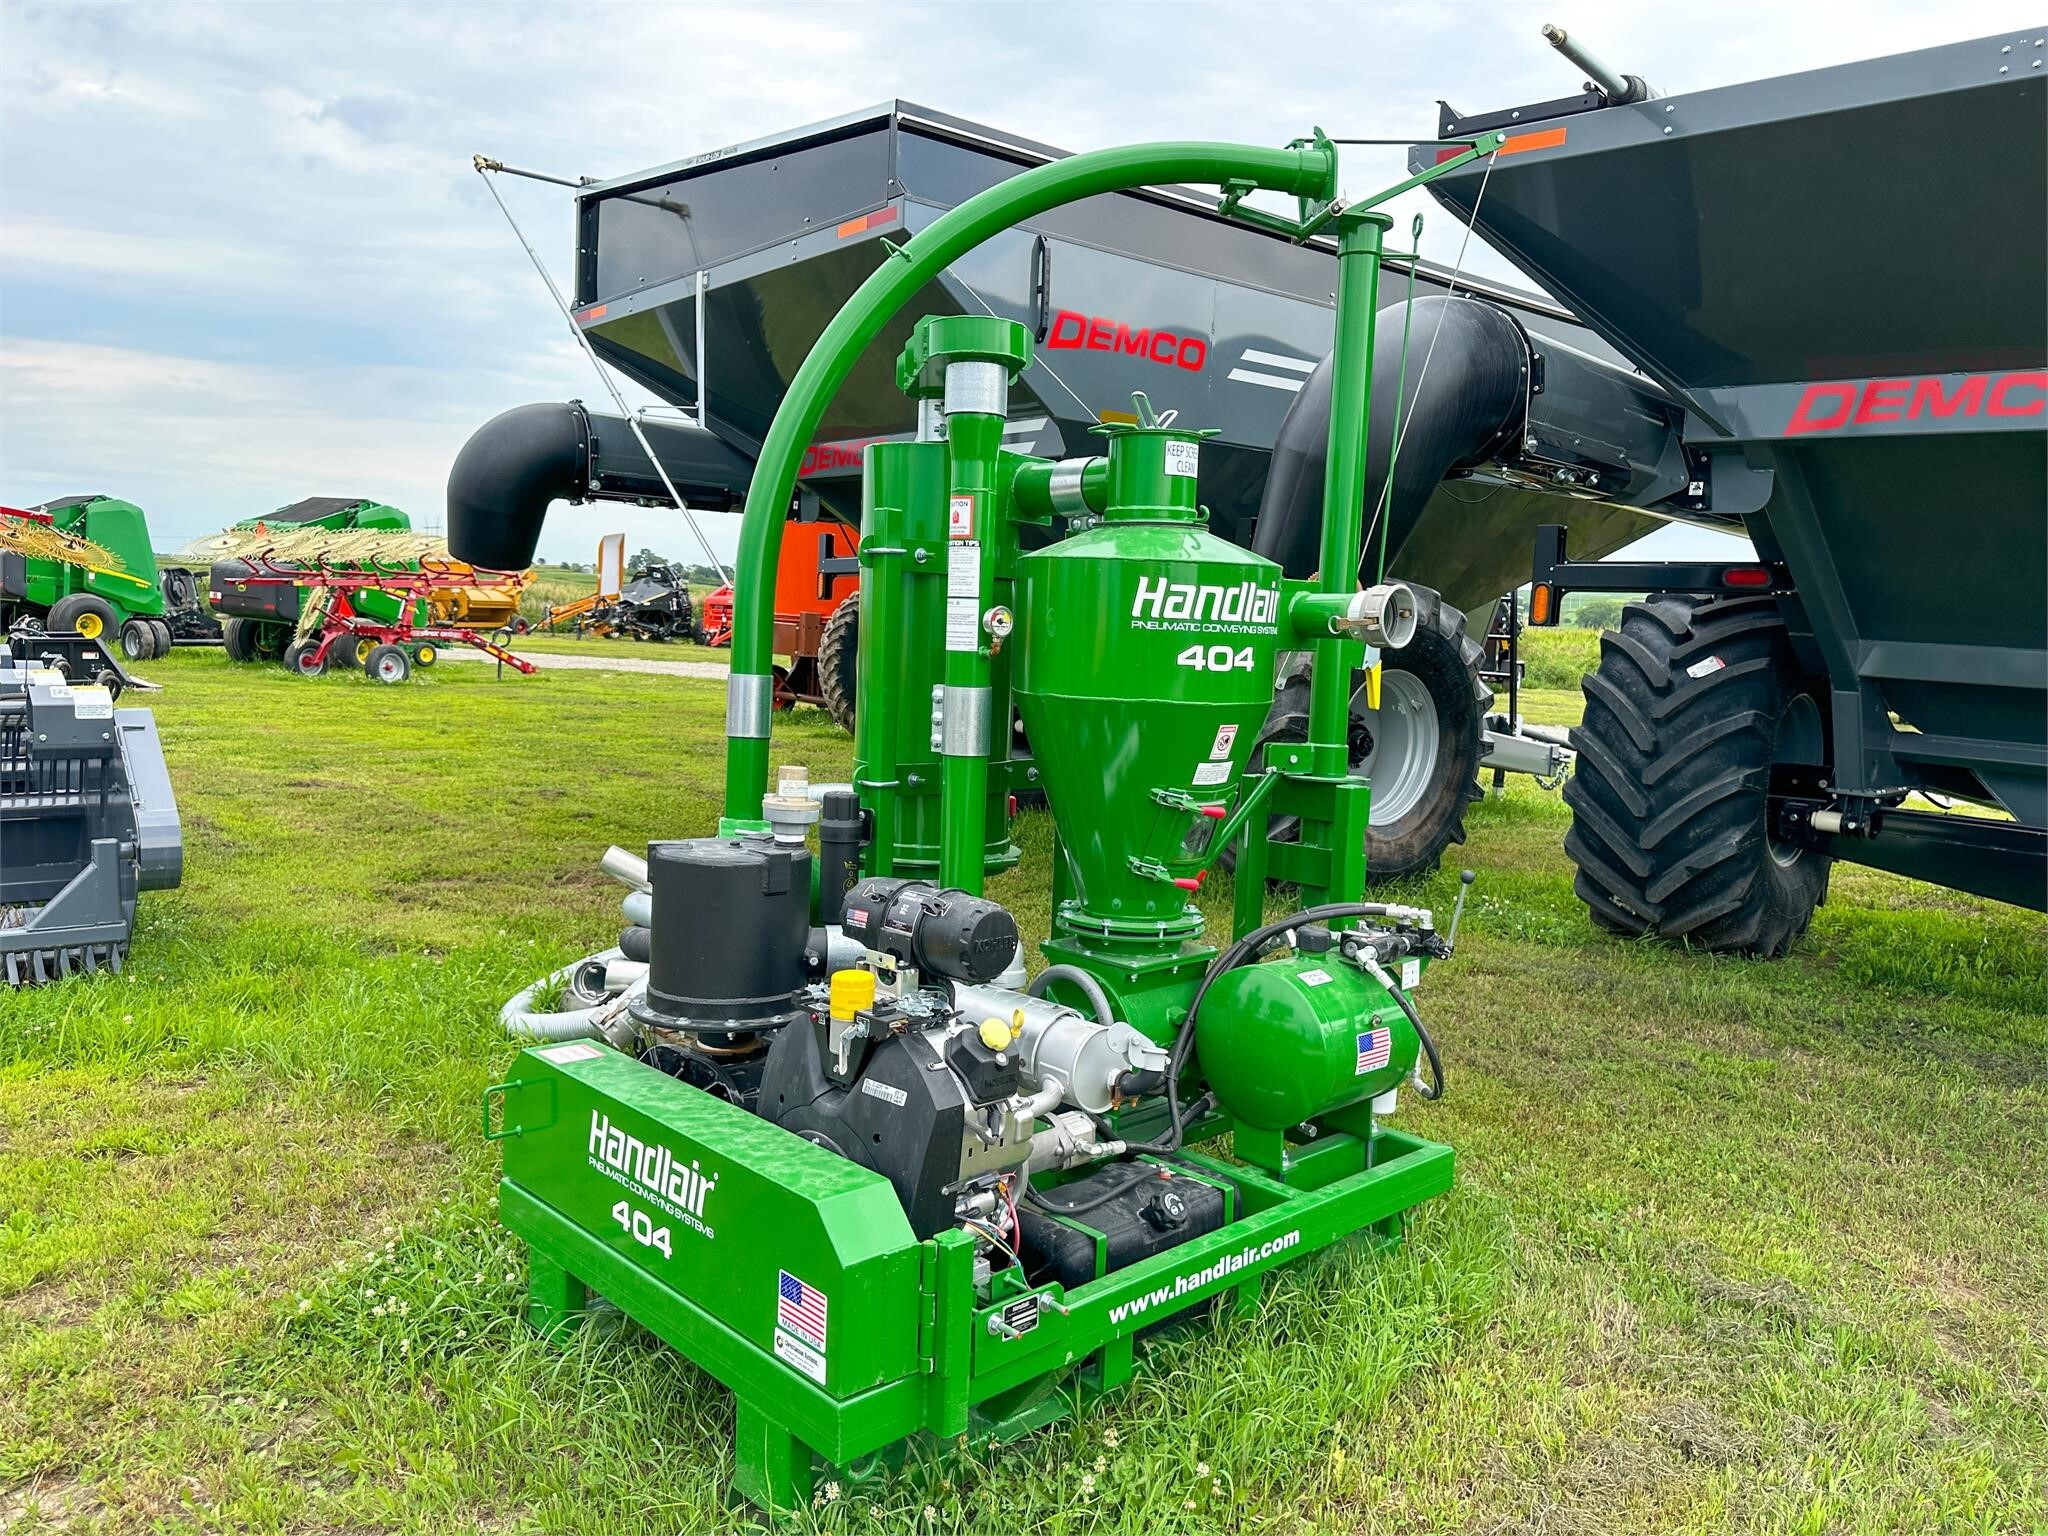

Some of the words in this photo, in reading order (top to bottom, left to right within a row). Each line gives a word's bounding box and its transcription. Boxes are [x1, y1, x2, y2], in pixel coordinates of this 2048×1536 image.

[1047, 309, 1206, 372] DEMCO
[1167, 444, 1185, 457] KEEP
[1176, 460, 1196, 474] CLEAN
[1131, 620, 1200, 632] PNEUMATIC
[1202, 623, 1257, 634] CONVEYING
[1177, 644, 1254, 672] 404
[588, 1155, 630, 1188] PNEUMATIC
[629, 1181, 675, 1216] CONVEYING
[674, 1207, 715, 1240] SYSTEMS
[612, 1200, 673, 1260] 404
[1108, 1229, 1300, 1325] www.handlair.com
[781, 1318, 800, 1336] MADE
[800, 1330, 808, 1340] IN
[808, 1335, 822, 1350] USA
